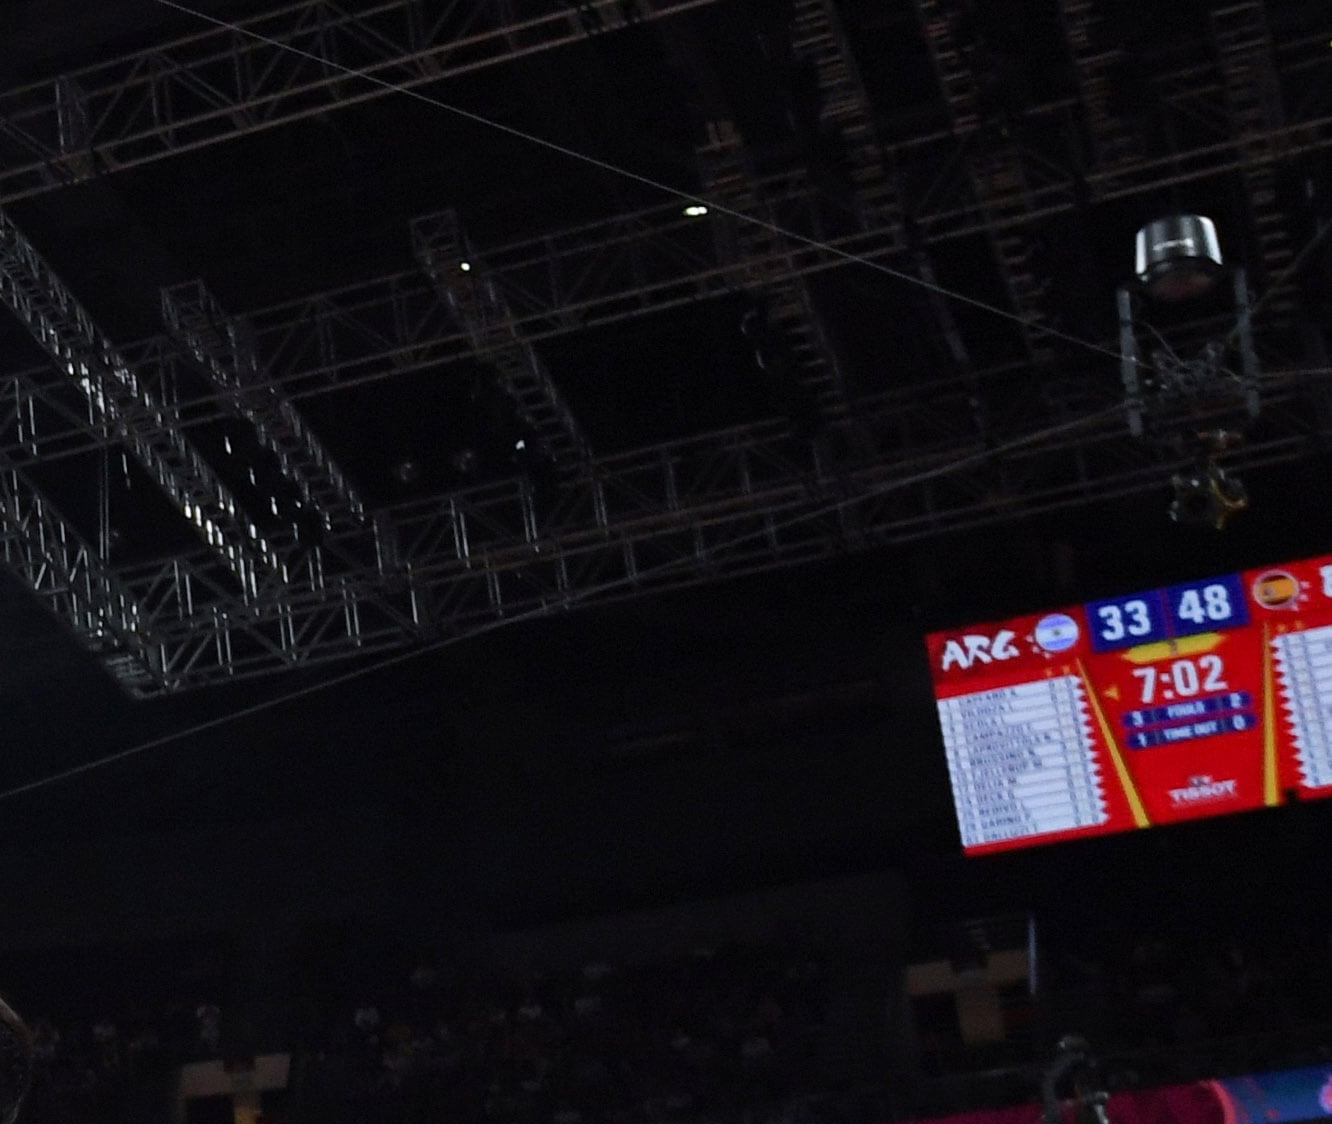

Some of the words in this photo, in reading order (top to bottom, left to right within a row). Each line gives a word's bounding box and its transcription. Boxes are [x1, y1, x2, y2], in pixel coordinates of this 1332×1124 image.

[1098, 599, 1153, 642] 33
[1178, 584, 1233, 624] 48
[942, 631, 1020, 671] ARG
[1132, 653, 1229, 704] 7:02
